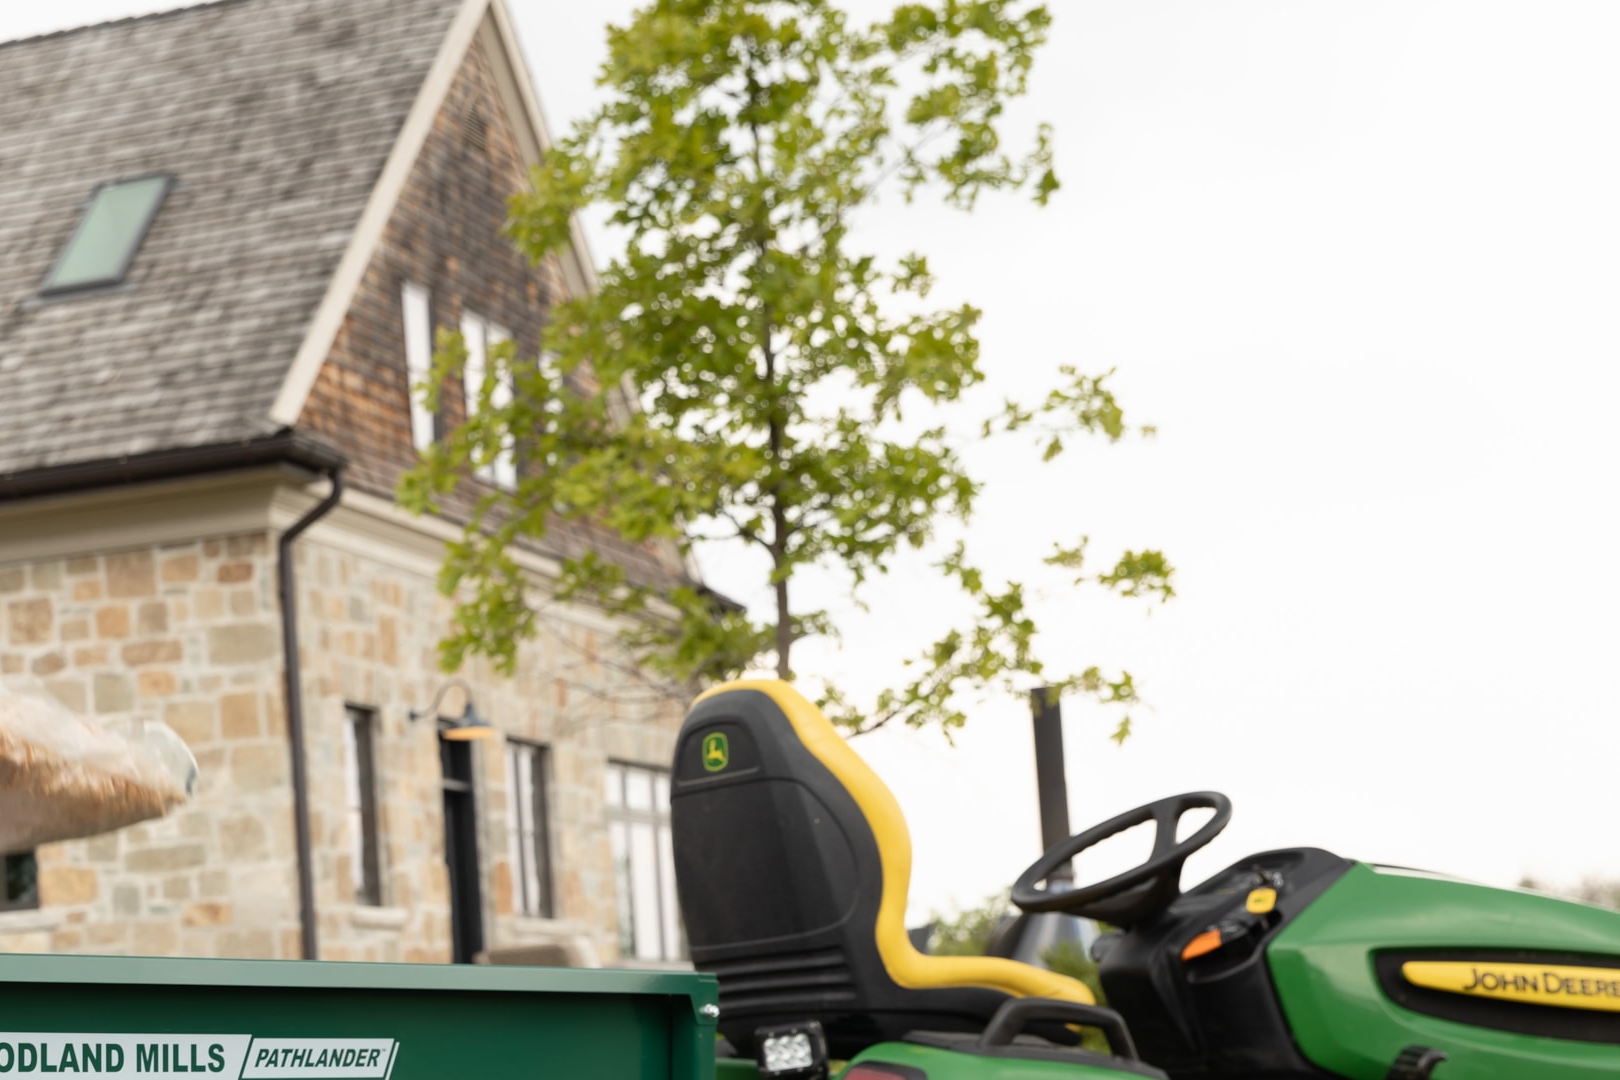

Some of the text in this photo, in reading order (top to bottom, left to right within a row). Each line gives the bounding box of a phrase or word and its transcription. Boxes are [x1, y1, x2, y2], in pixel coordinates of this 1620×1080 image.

[1463, 966, 1620, 997] JOHN DEERE
[135, 1042, 226, 1073] MILLS
